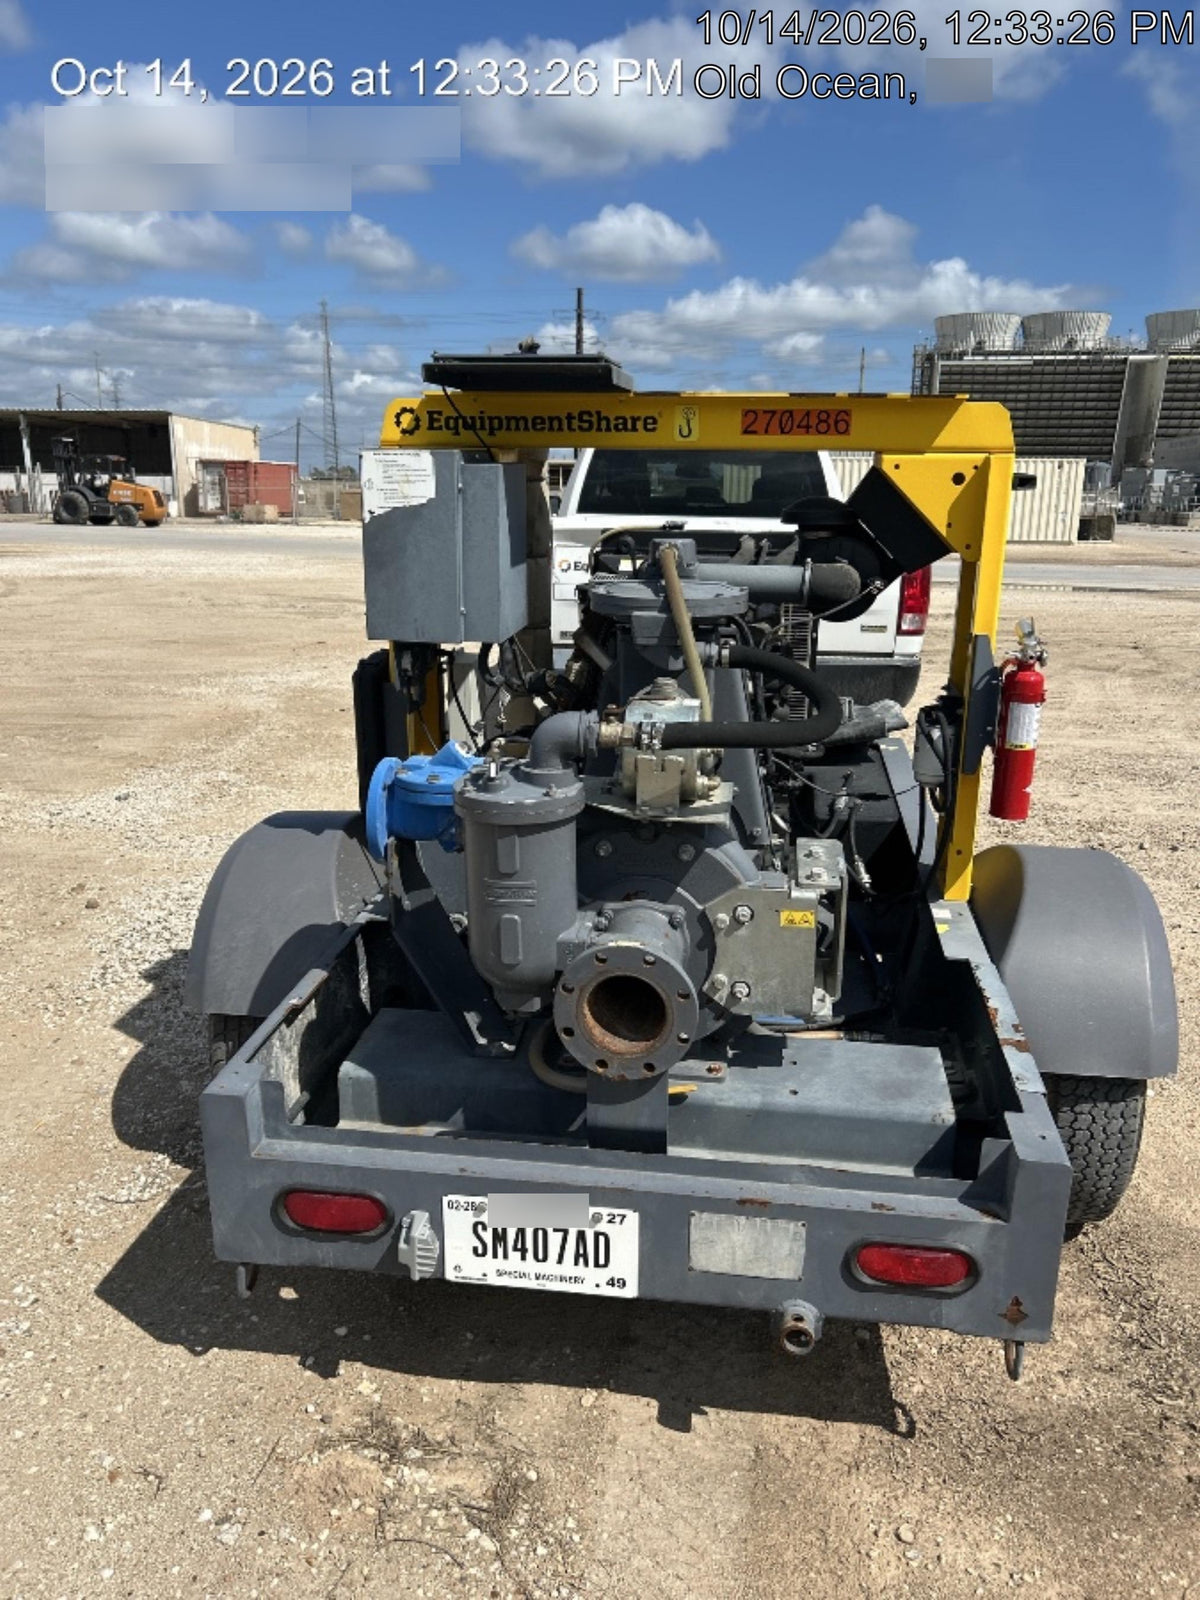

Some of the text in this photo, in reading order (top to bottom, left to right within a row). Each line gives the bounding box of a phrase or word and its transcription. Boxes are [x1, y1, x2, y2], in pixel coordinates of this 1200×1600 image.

[427, 409, 658, 435] EquipmentShare
[743, 409, 850, 435] 270486
[606, 1212, 627, 1226] 27
[472, 1220, 611, 1269] SM407AD
[495, 1268, 531, 1282] SPECIAL
[534, 1272, 586, 1286] MACHINERY
[606, 1276, 627, 1290] 49
